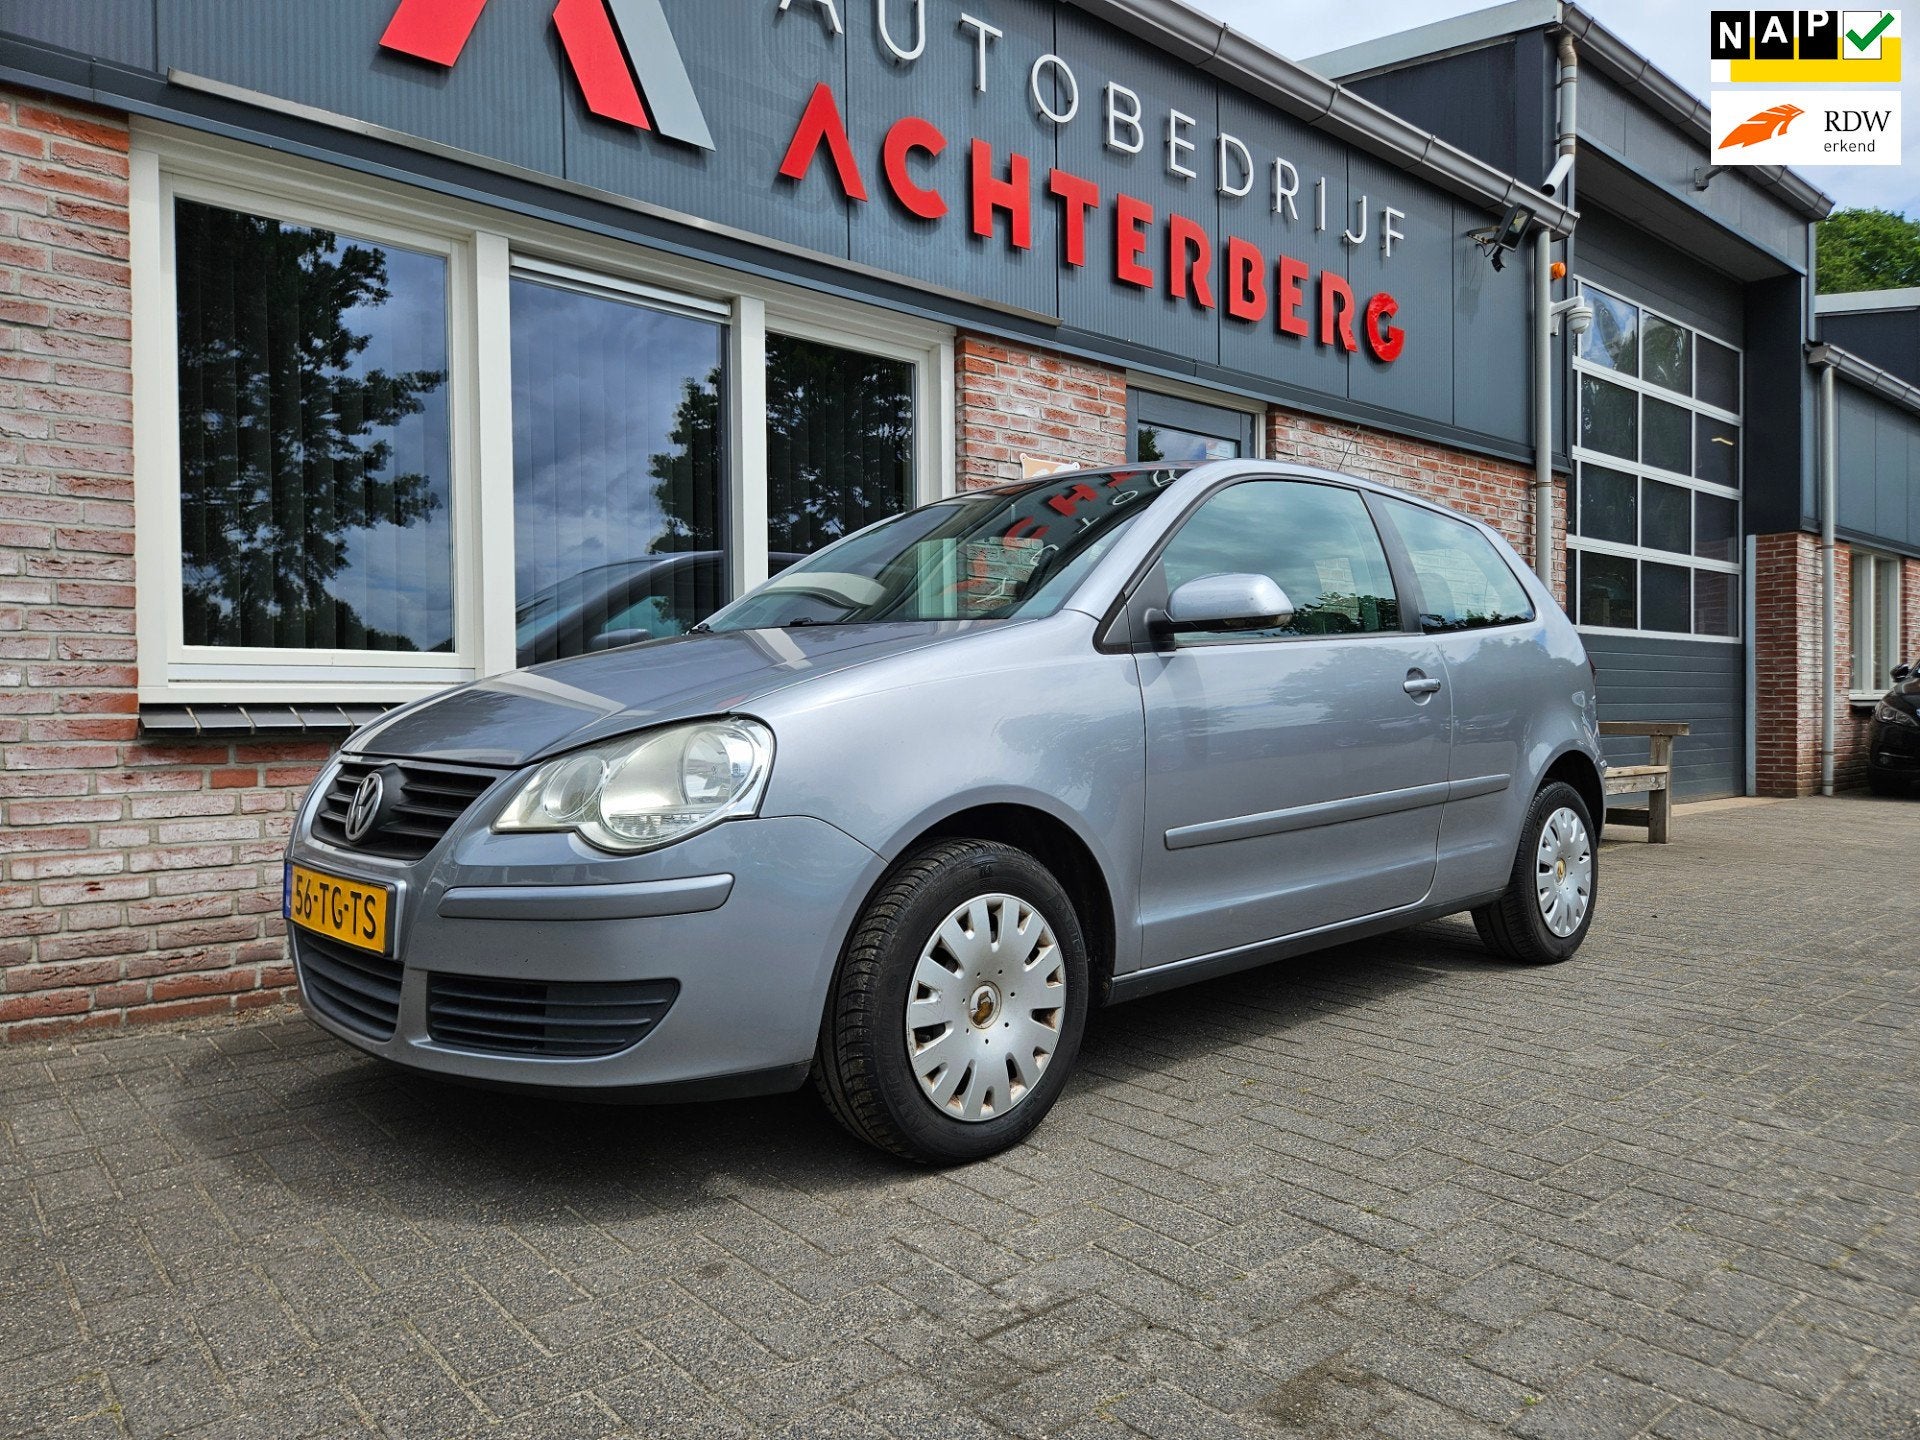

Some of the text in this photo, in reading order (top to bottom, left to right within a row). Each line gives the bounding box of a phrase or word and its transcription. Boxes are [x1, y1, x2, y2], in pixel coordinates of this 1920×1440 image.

[779, 0, 1405, 257] UTOBEDRIJF
[779, 82, 1405, 362] ACHTERBERG
[295, 875, 377, 940] 56-TG-TS
